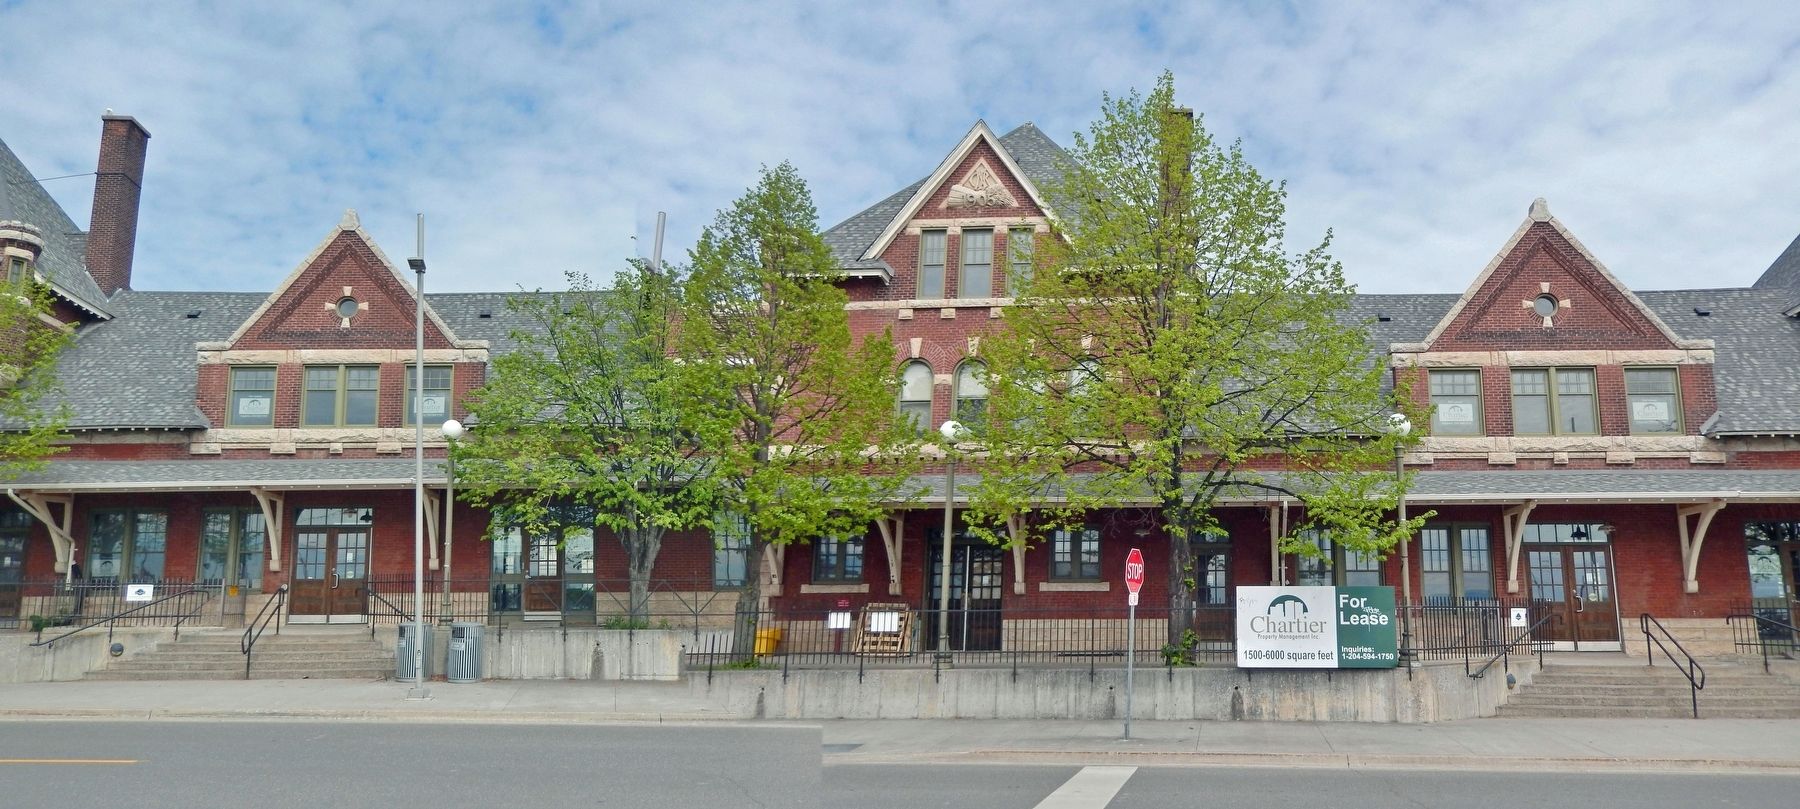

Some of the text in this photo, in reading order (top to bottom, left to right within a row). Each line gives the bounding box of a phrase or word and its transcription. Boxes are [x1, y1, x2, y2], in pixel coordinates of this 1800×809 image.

[962, 192, 996, 208] 1905
[1127, 563, 1143, 580] STOP
[1339, 594, 1368, 609] For
[1250, 616, 1327, 633] Chartier
[1340, 611, 1389, 625] Lease
[1243, 649, 1334, 662] 1500-6000 square feet
[1341, 645, 1375, 653] Inquiries:
